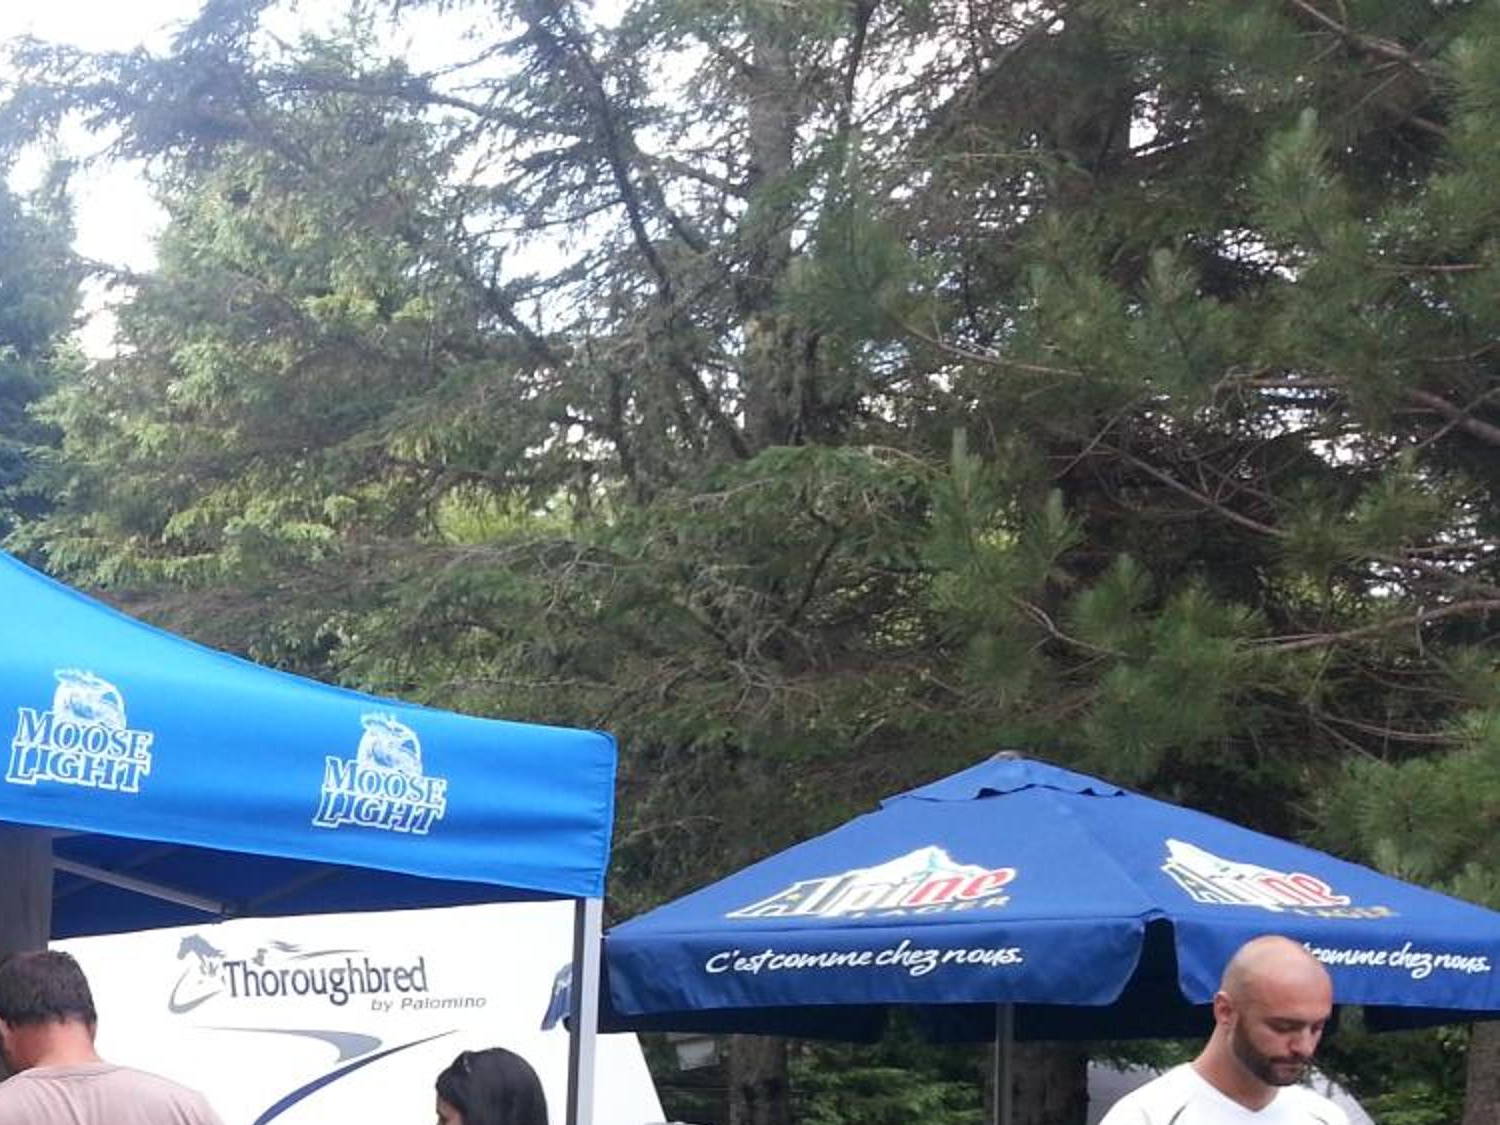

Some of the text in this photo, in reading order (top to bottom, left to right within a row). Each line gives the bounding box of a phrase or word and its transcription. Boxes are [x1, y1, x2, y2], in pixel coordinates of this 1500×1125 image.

[16, 707, 153, 759] MOOSE
[6, 743, 150, 793] LIGHT
[323, 756, 446, 805] MOOSE
[313, 790, 442, 834] LIGHT
[726, 868, 1016, 917] Alpine
[223, 956, 428, 1006] Thoroughbred
[705, 940, 1024, 976] C'est comme chez nous.
[1388, 942, 1435, 979] chez
[371, 997, 487, 1012] by Palomino
